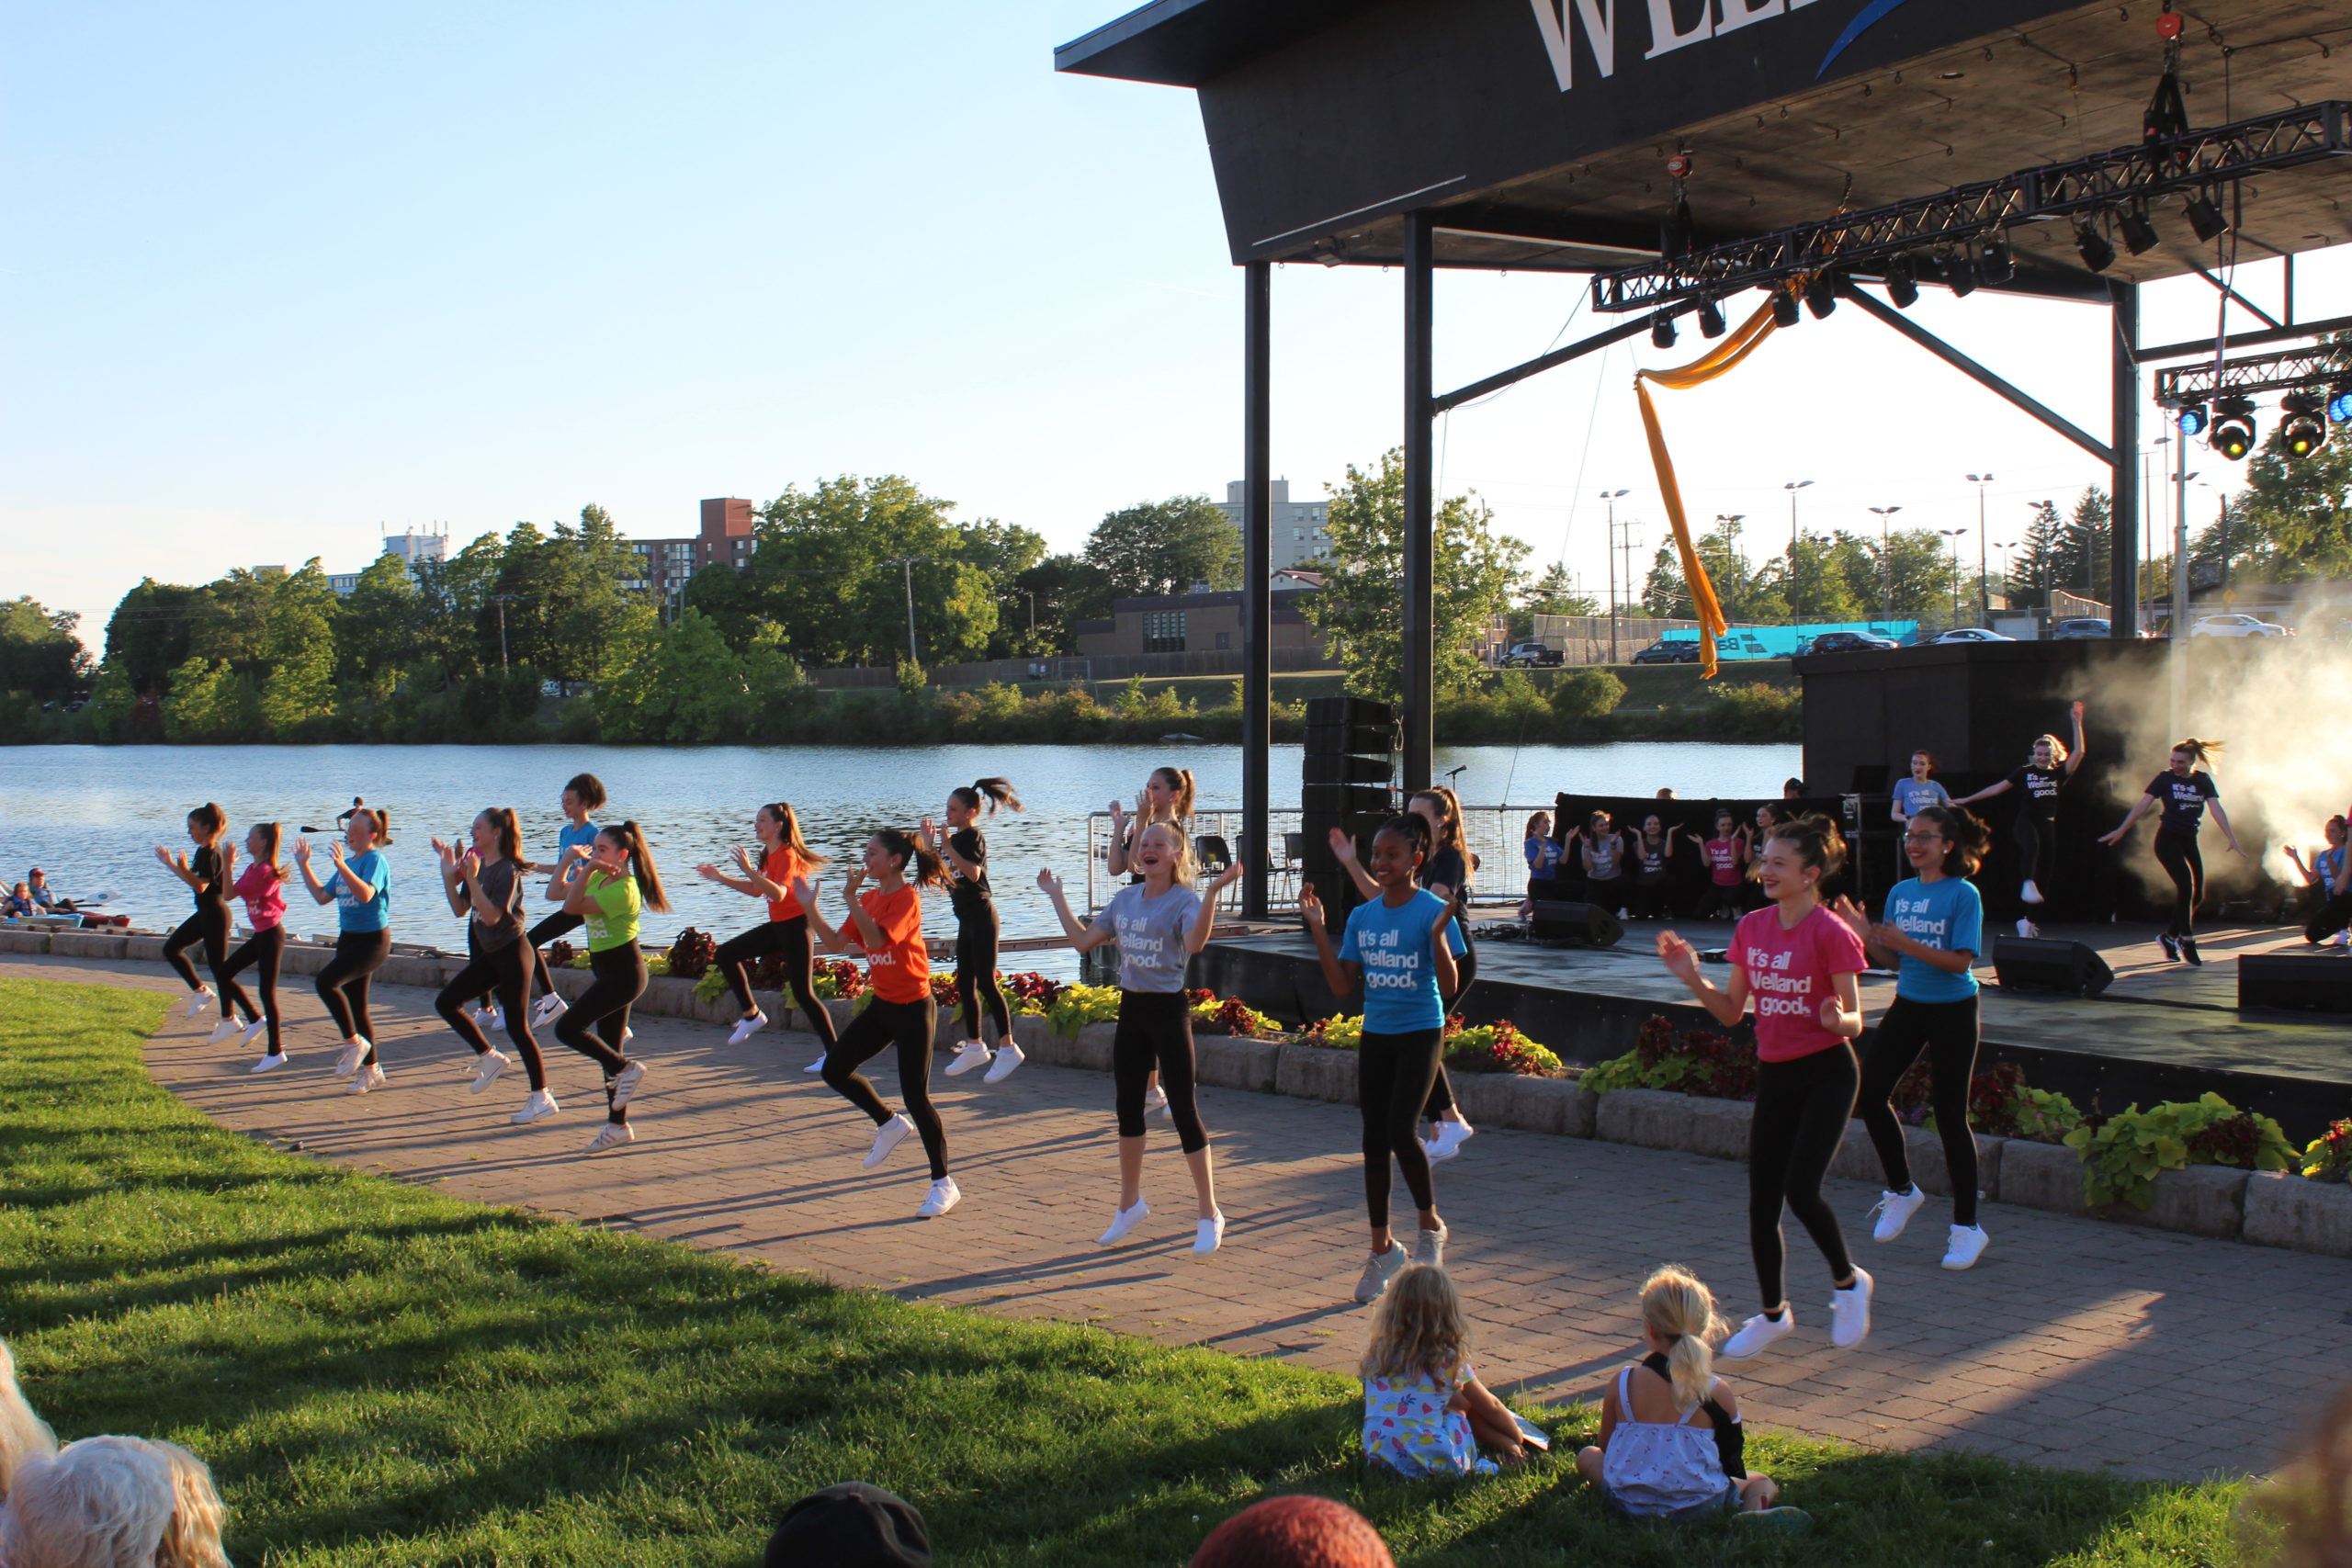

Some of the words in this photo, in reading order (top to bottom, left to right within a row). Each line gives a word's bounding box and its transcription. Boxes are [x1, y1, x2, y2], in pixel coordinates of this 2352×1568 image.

[1912, 898, 1930, 914] all
[1130, 917, 1148, 933] all
[1358, 930, 1377, 948] It's
[1379, 929, 1399, 947] all
[1770, 950, 1792, 970] all
